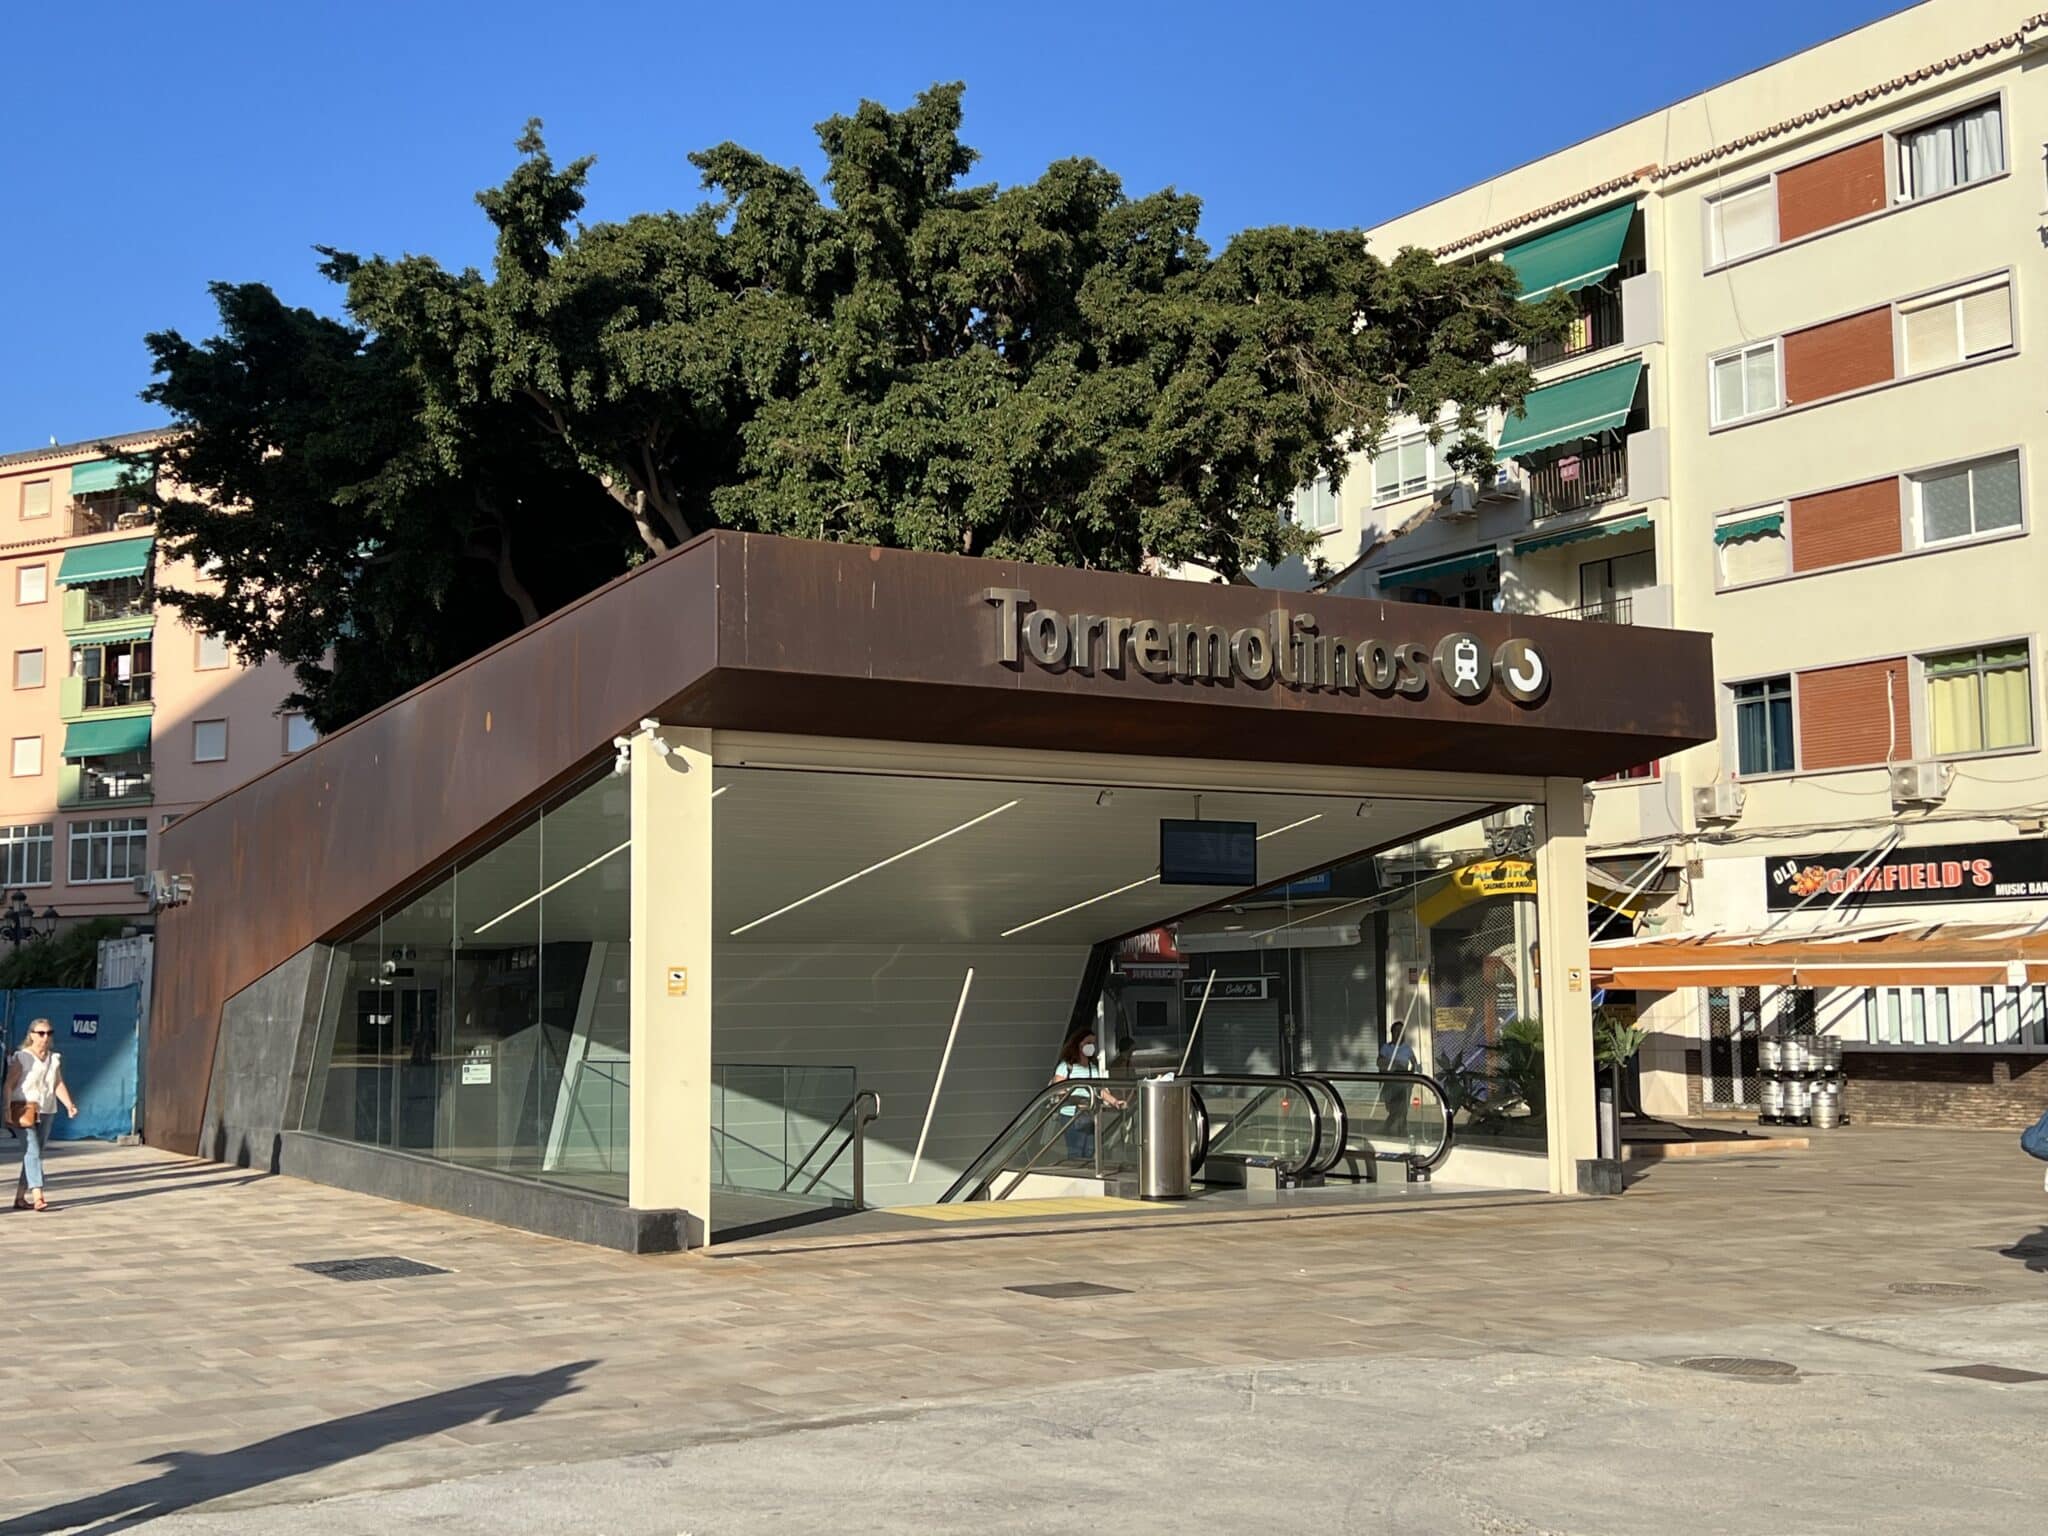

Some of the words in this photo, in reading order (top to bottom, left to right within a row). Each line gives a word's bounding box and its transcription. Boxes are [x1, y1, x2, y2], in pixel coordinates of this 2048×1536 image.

[984, 587, 1429, 692] Torremolinos
[1773, 860, 1798, 885] OLD
[1506, 881, 1514, 889] DE
[1995, 882, 2027, 896] MUSIC
[2028, 881, 2048, 895] BAR
[73, 1020, 97, 1034] VIAS
